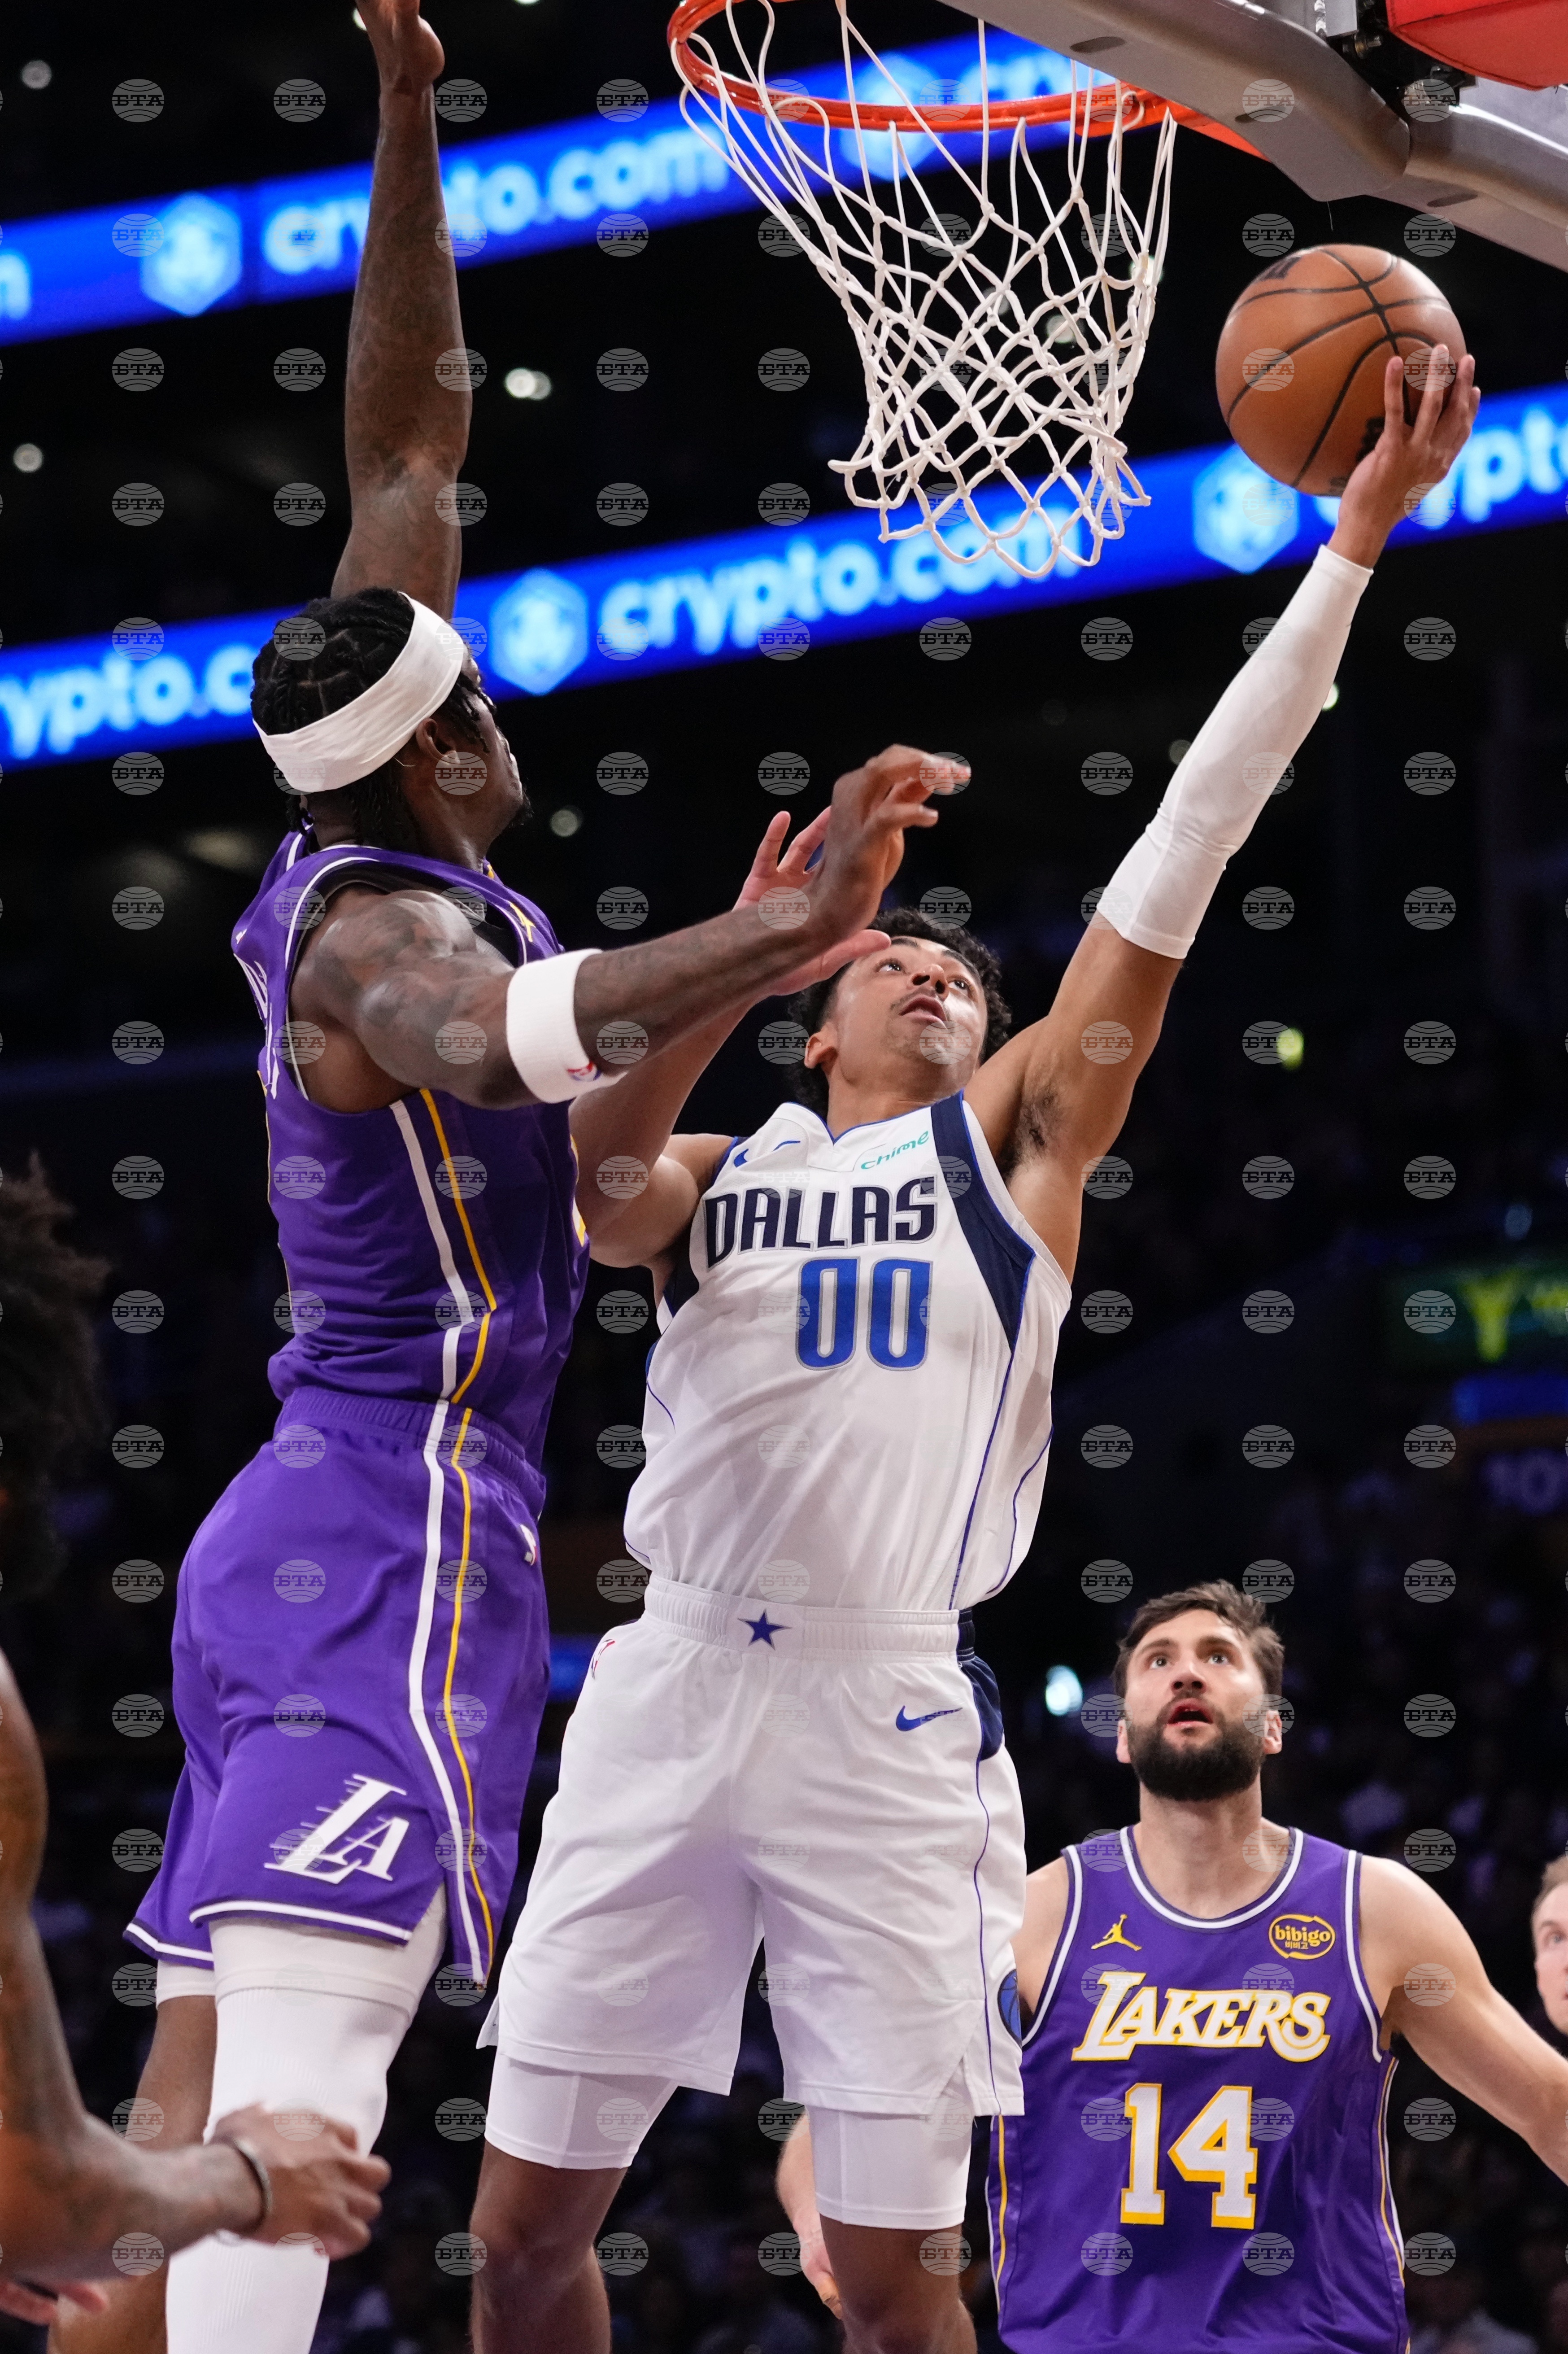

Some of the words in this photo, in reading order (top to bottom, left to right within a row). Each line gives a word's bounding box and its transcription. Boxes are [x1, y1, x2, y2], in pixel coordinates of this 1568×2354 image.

[861, 1131, 929, 1170] chime
[703, 1174, 938, 1272] DALLAS
[795, 1257, 934, 1371] 00
[1275, 1925, 1331, 1947] bibigo
[1071, 1971, 1331, 2062] LAKERS
[1120, 2083, 1258, 2229] 14
